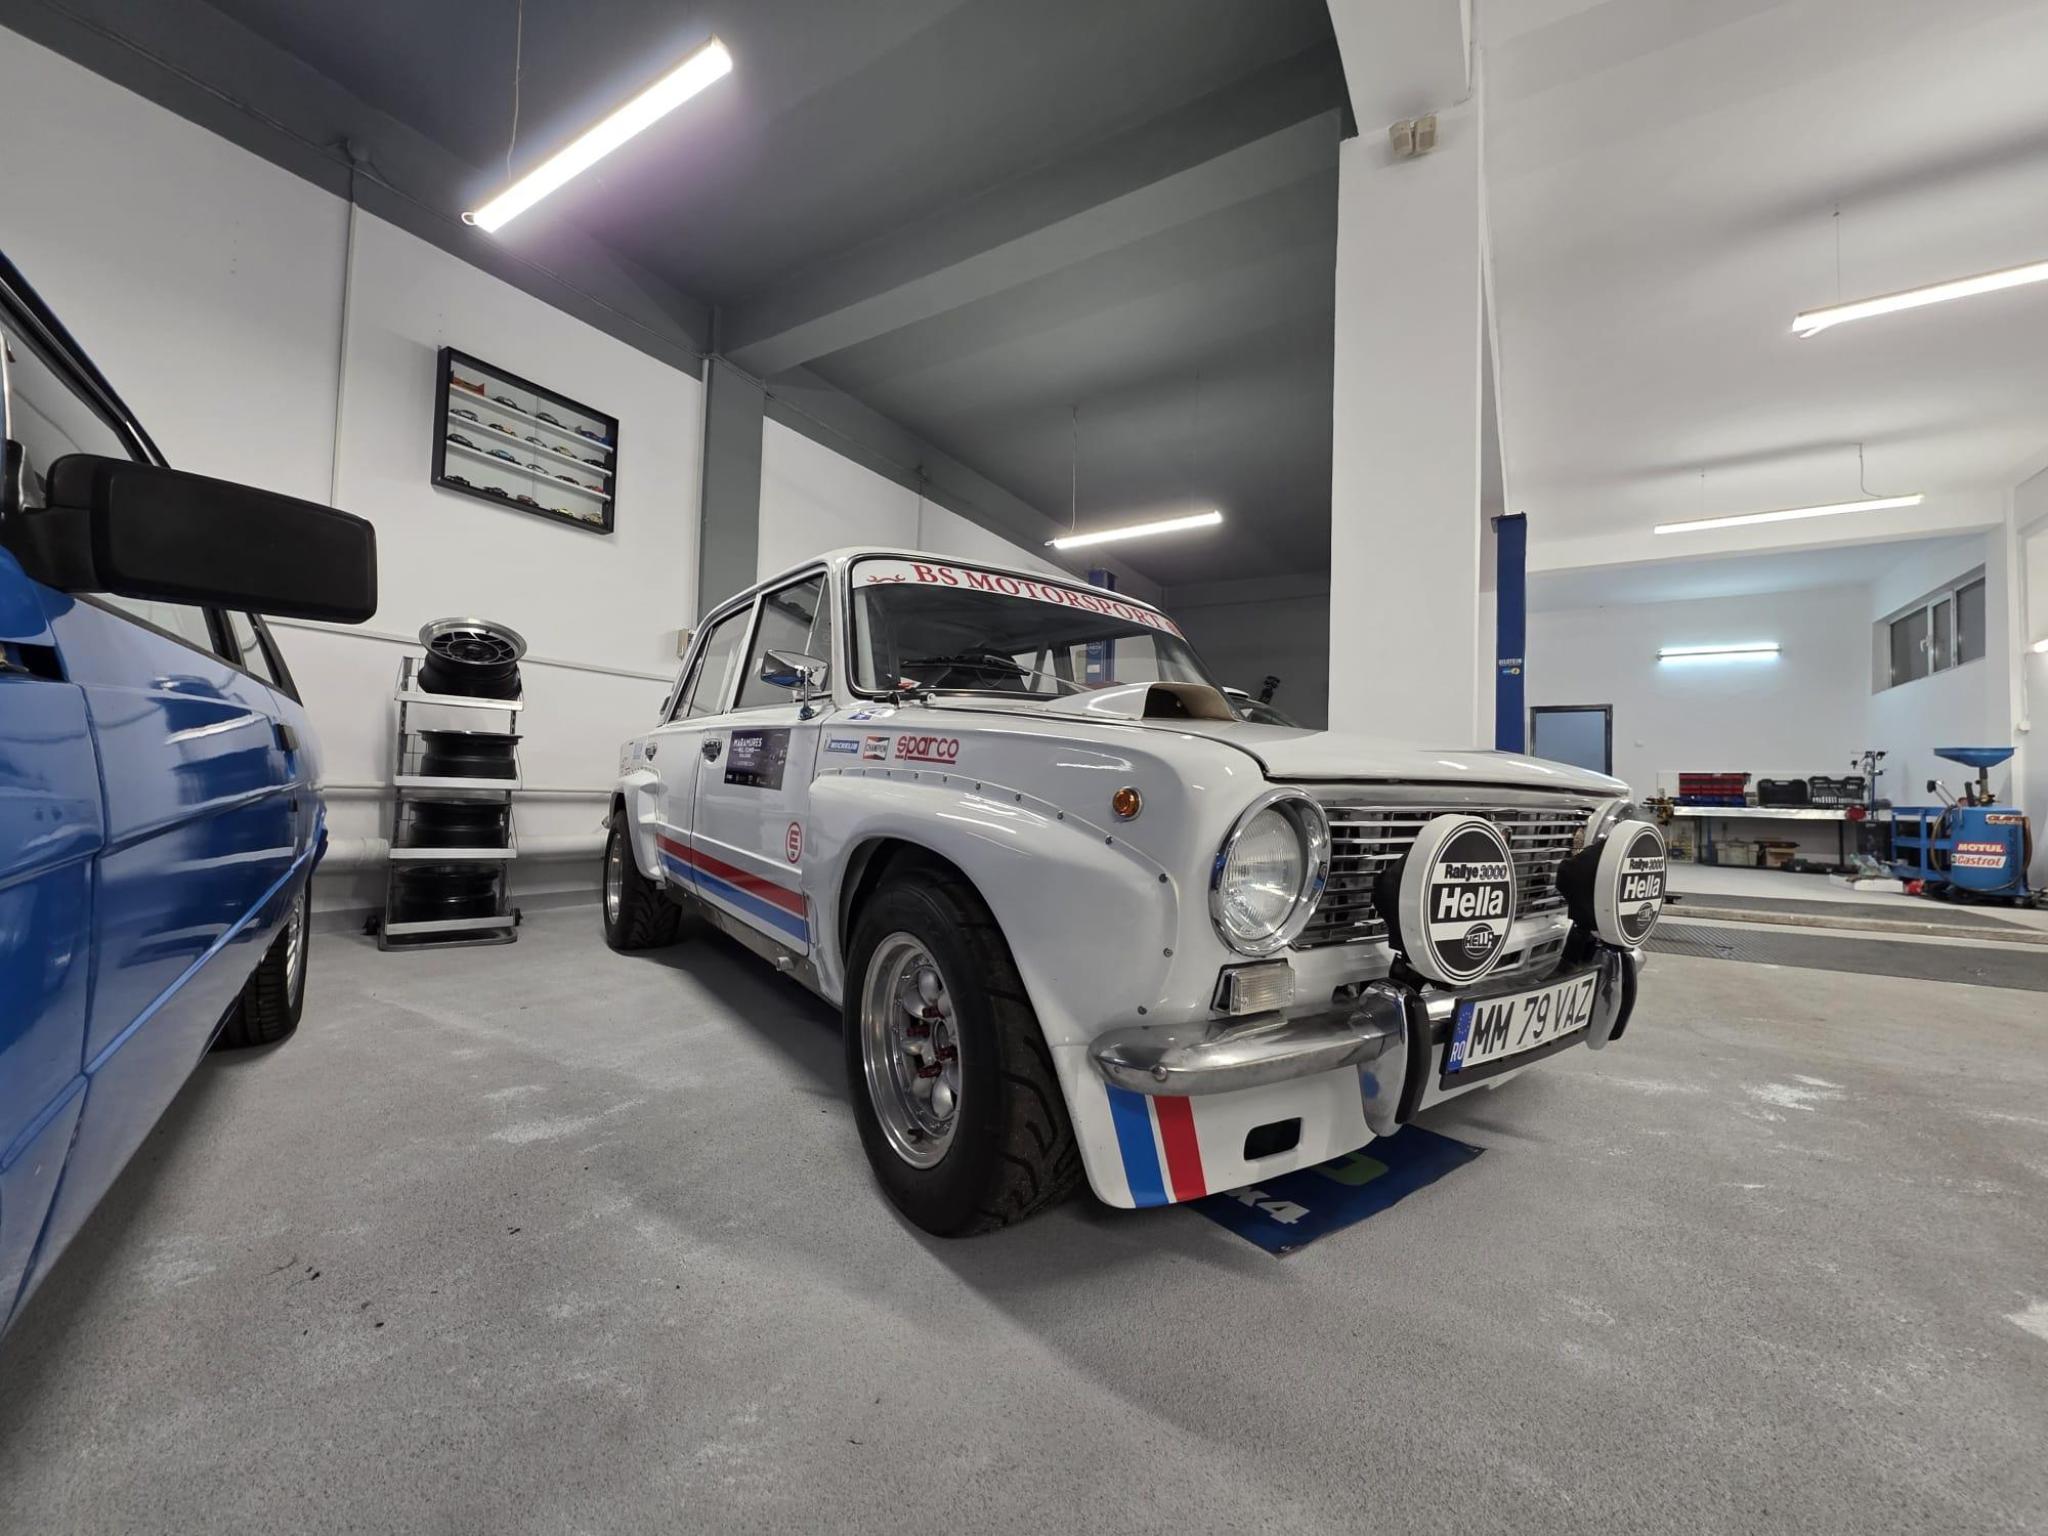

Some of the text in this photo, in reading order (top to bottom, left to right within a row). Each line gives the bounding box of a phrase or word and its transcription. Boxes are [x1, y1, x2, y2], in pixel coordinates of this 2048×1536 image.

[910, 563, 1165, 628] BS MOTORSPORT
[896, 735, 960, 761] sparco
[1957, 843, 2003, 852] MOTUL
[1444, 864, 1507, 881] Rallye 3000
[1957, 855, 2002, 867] Castrol
[1623, 874, 1660, 899] Hella
[1437, 886, 1504, 919] Hella
[1465, 931, 1494, 949] HELLA
[1468, 980, 1594, 1058] MM 79 VAZ
[1449, 1040, 1466, 1062] RO
